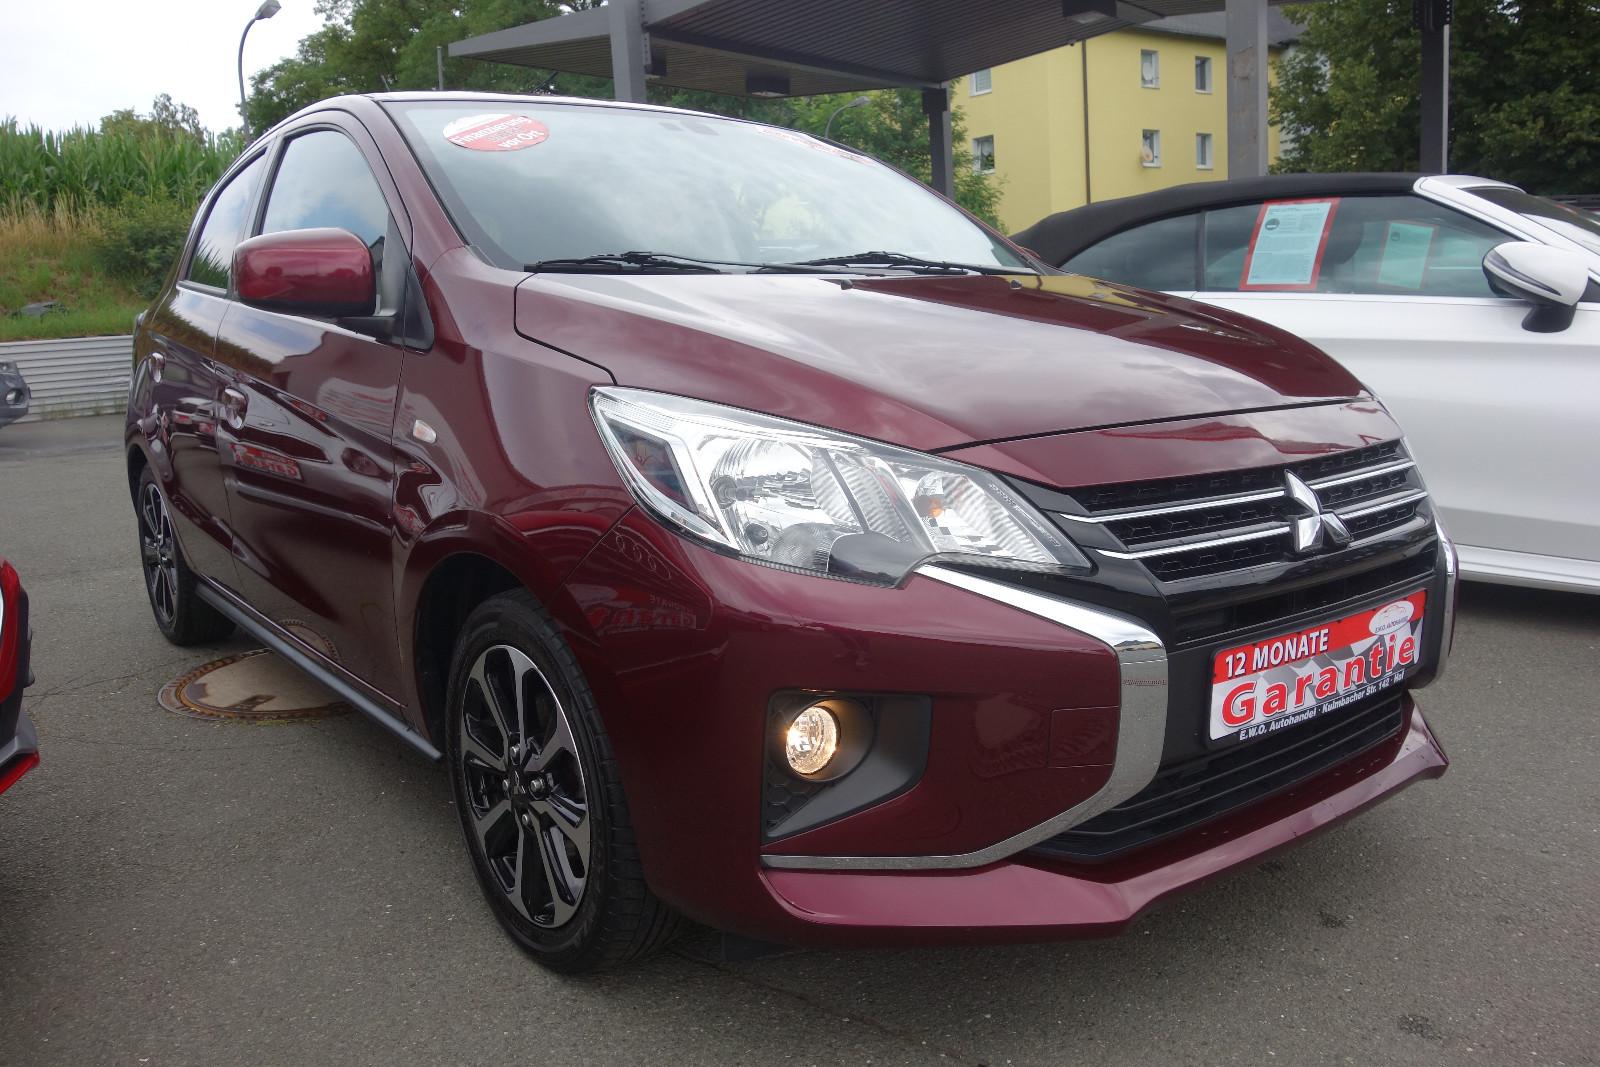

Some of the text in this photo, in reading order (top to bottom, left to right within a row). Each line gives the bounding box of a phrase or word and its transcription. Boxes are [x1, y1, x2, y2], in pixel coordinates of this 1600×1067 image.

[1222, 633, 1416, 727] Garantie
[1225, 628, 1329, 678] 12 MONATE
[1239, 724, 1267, 741] E.W.O.
[1269, 707, 1317, 732] Autohandel
[1322, 690, 1365, 714] Kulmbacher
[1366, 685, 1377, 696] Str.
[1379, 678, 1389, 689] 142
